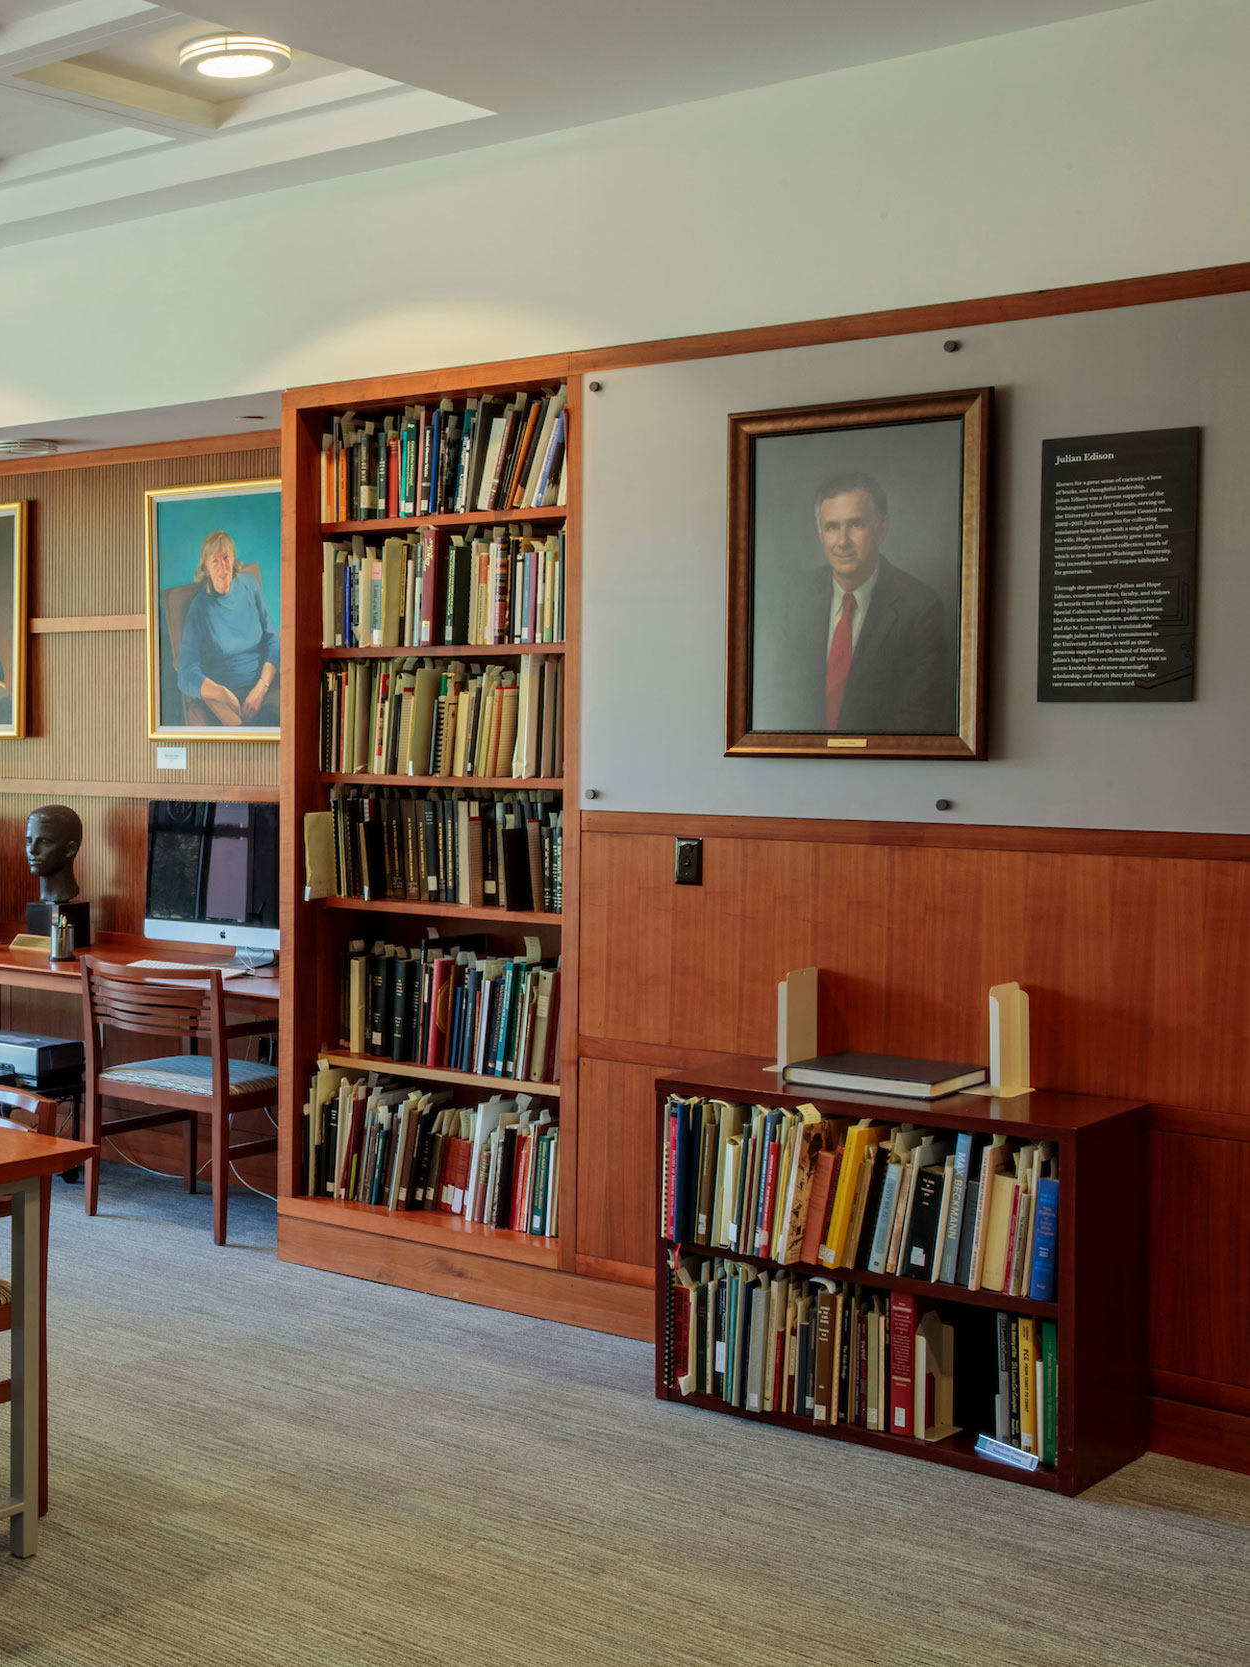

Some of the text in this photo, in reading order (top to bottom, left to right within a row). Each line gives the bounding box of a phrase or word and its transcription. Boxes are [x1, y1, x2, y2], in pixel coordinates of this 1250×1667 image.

[1055, 452, 1114, 465] Julian Edison
[1090, 486, 1117, 494] thoughtful
[1123, 492, 1147, 500] supporter
[1056, 504, 1085, 512] Washington
[1086, 502, 1111, 510] University
[1065, 512, 1090, 520] University
[1055, 544, 1091, 552] internationally
[1113, 549, 1143, 557] Washington
[948, 1152, 966, 1239] MAX BECKMANN
